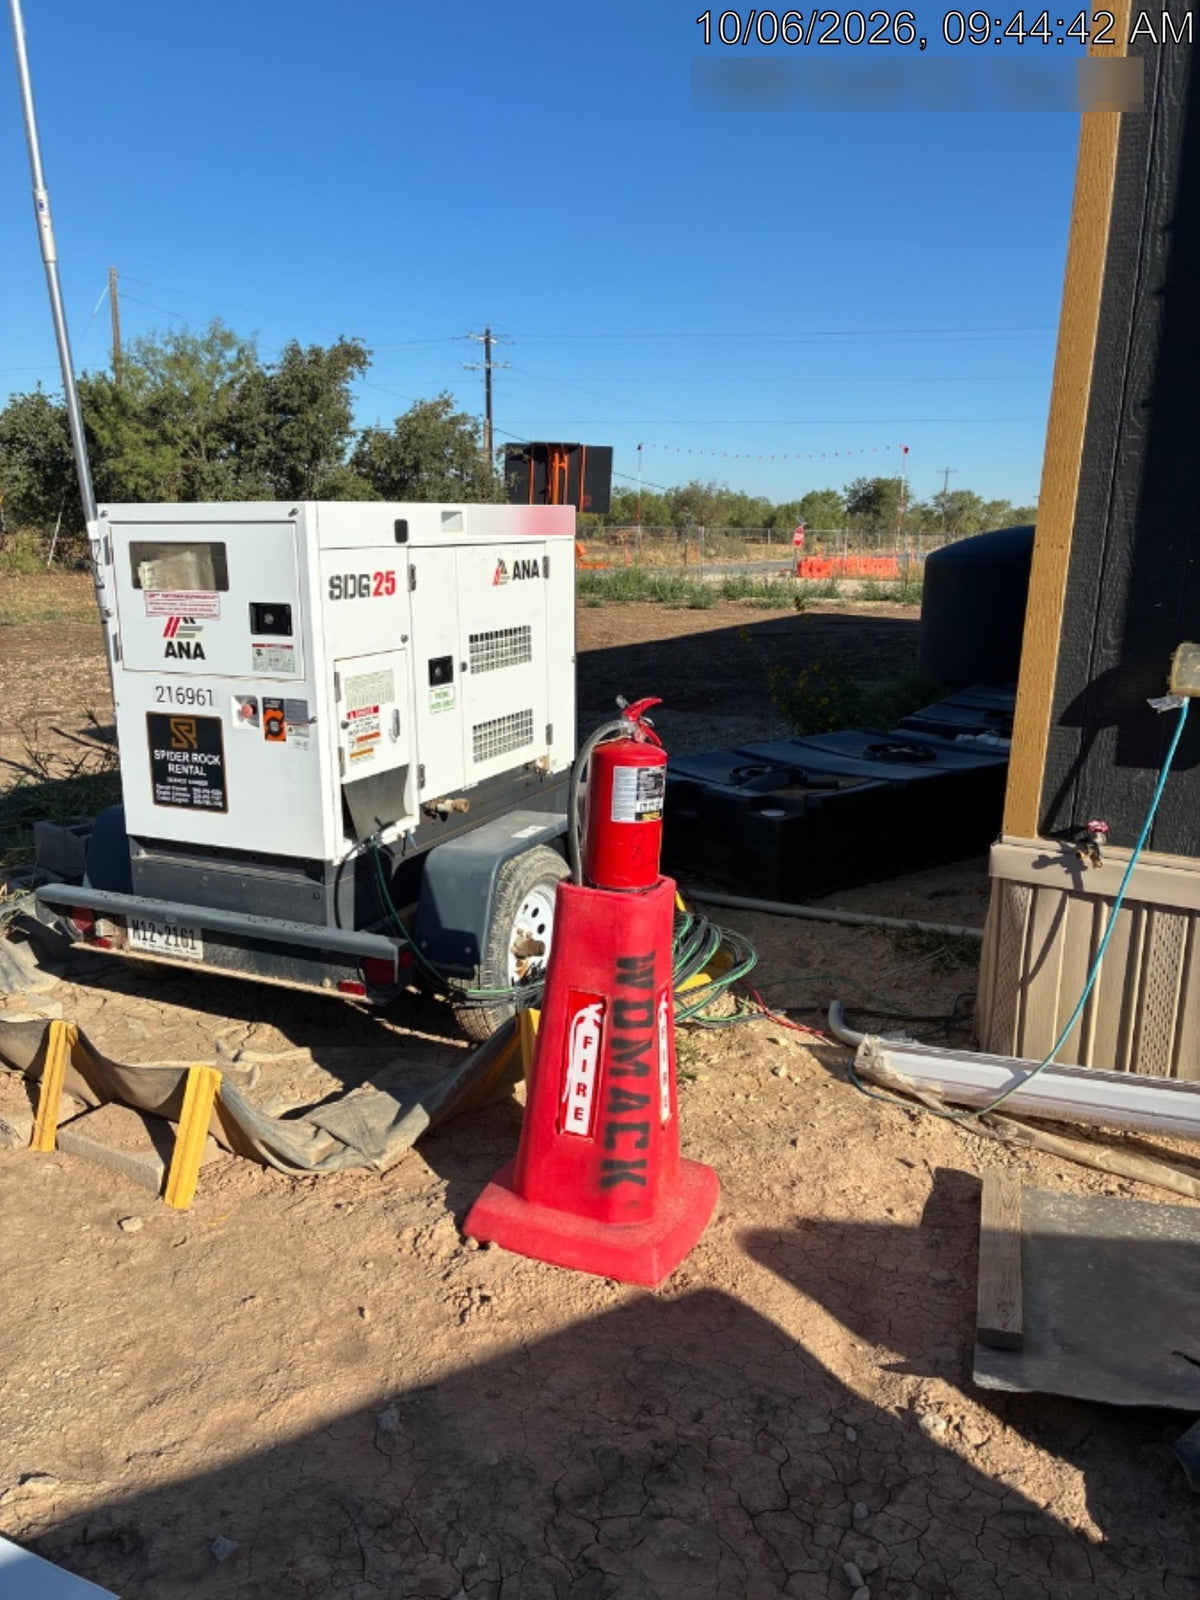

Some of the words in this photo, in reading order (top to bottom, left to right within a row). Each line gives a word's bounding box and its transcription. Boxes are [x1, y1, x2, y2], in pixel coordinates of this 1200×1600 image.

[512, 559, 540, 581] ANA
[164, 641, 206, 660] ANA
[155, 685, 214, 707] 216961
[153, 749, 190, 763] SPIDER
[191, 752, 221, 766] ROCK
[168, 762, 207, 777] RENTAL
[573, 1035, 594, 1122] FIRE
[601, 952, 655, 1188] WOMACK
